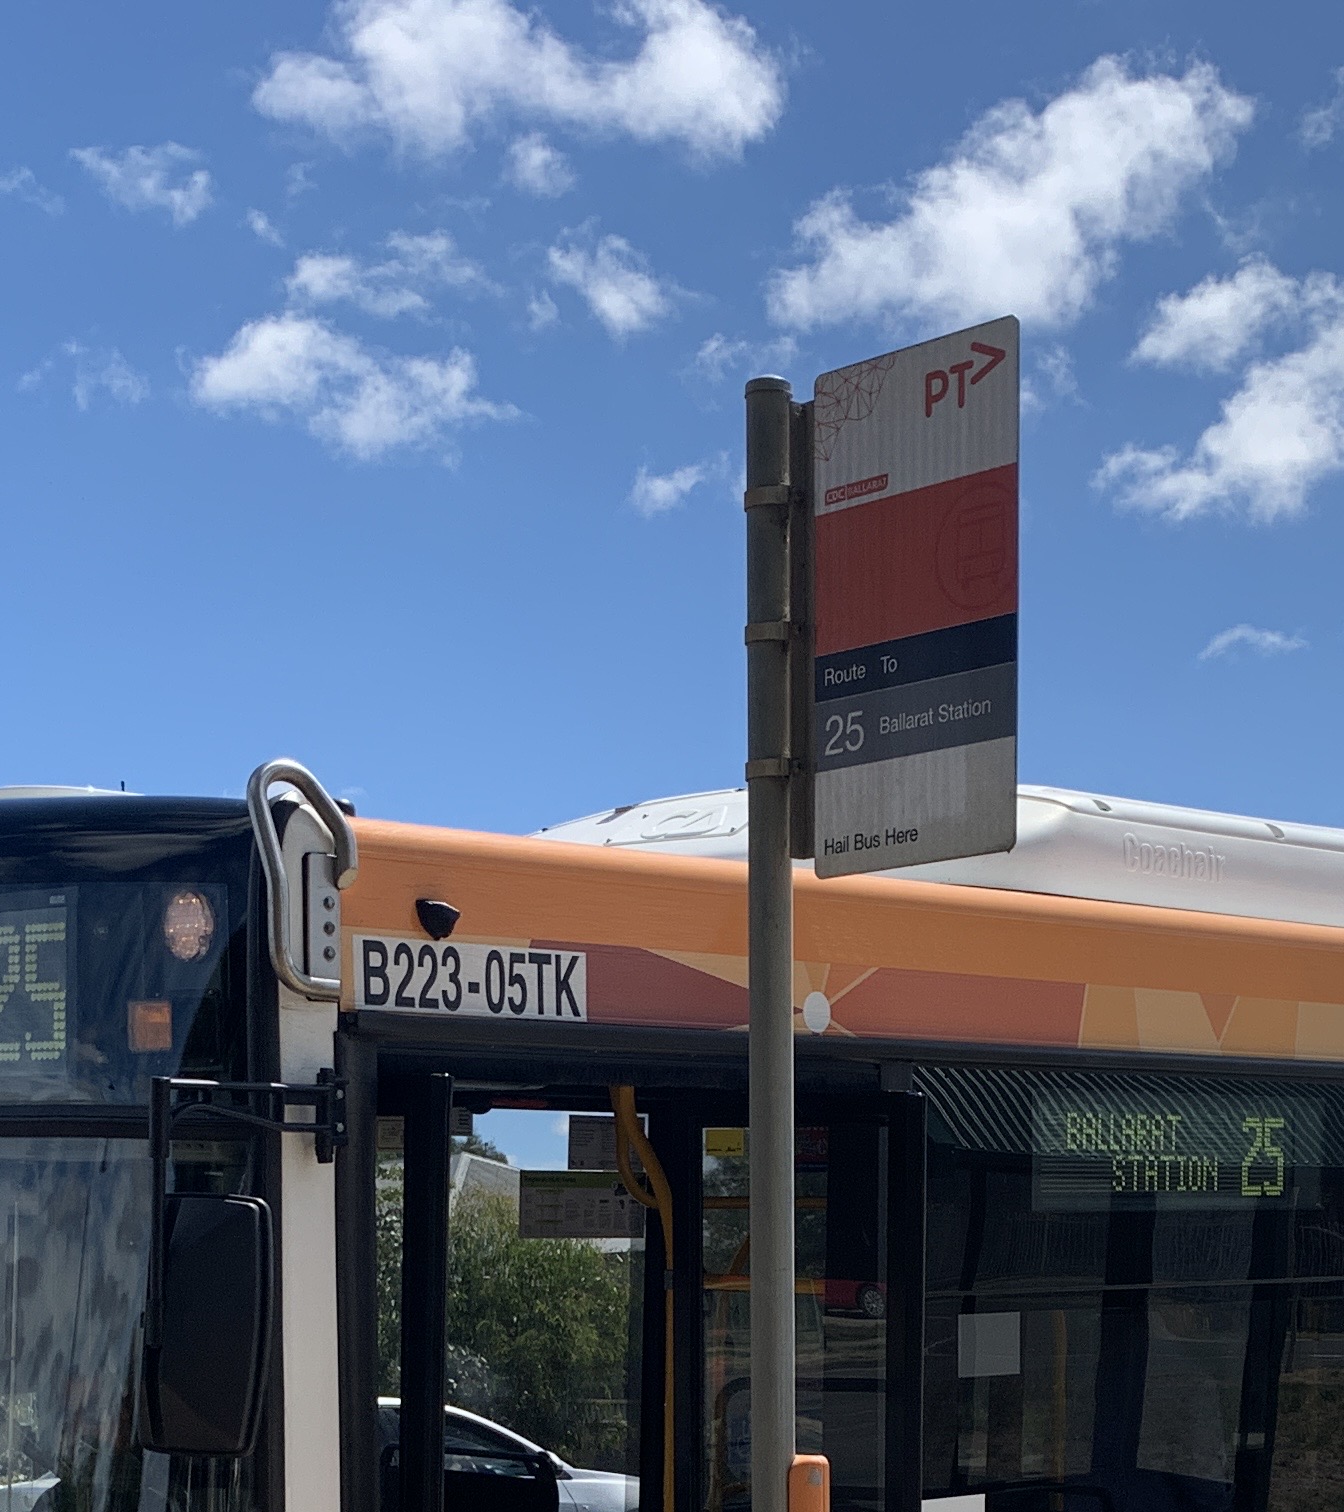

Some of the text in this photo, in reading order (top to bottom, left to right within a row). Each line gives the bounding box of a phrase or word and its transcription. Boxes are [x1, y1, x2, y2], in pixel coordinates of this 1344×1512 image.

[925, 359, 974, 418] PT
[824, 655, 898, 686] Route To
[824, 699, 992, 756] 25 Ballarat Station
[824, 828, 919, 856] Hail Bus Here
[1123, 832, 1226, 882] Coachair
[362, 939, 581, 1018] B223-05TK
[1066, 1112, 1182, 1151] BALLARAT
[1112, 1155, 1218, 1192] STATION
[1241, 1117, 1285, 1197] 25
